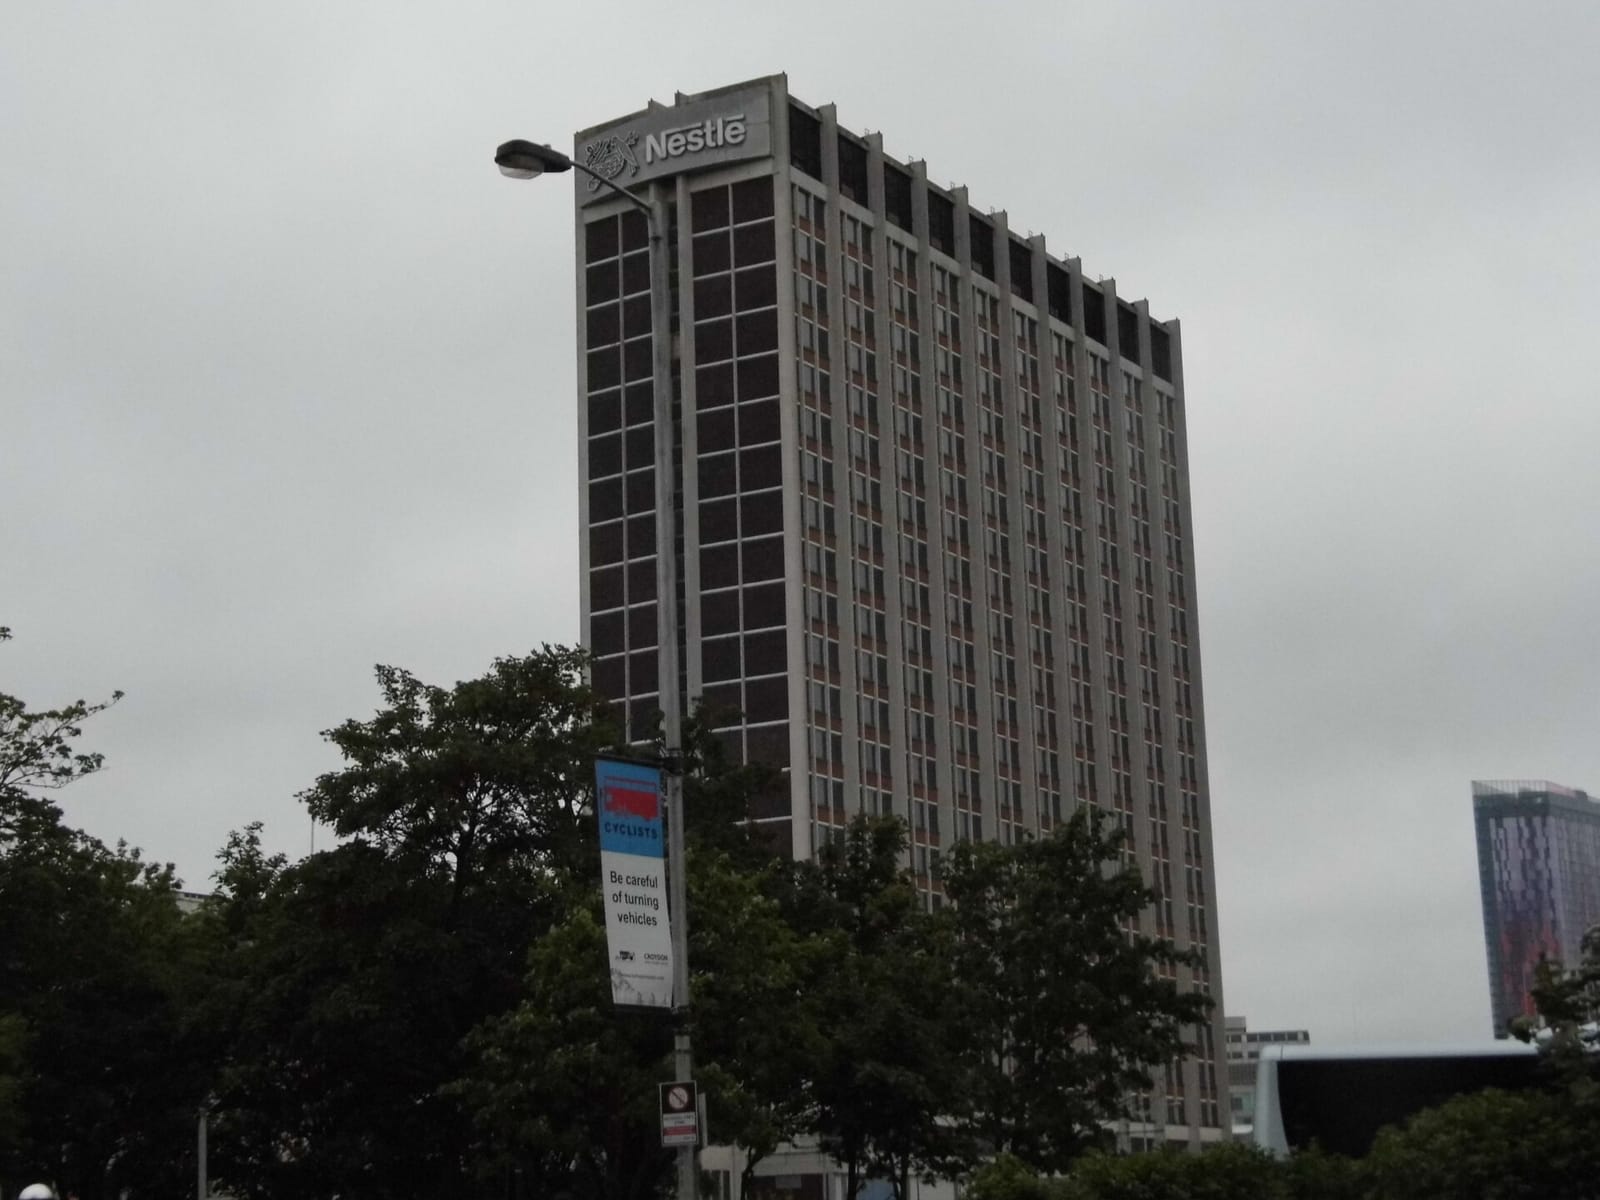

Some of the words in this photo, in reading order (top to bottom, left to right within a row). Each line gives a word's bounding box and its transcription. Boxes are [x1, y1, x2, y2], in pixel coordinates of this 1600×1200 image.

[604, 821, 658, 839] CYCLISTS
[610, 870, 623, 884] Be
[625, 874, 658, 889] careful
[612, 890, 622, 904] of
[624, 893, 659, 911] turning
[617, 912, 658, 926] vehicles
